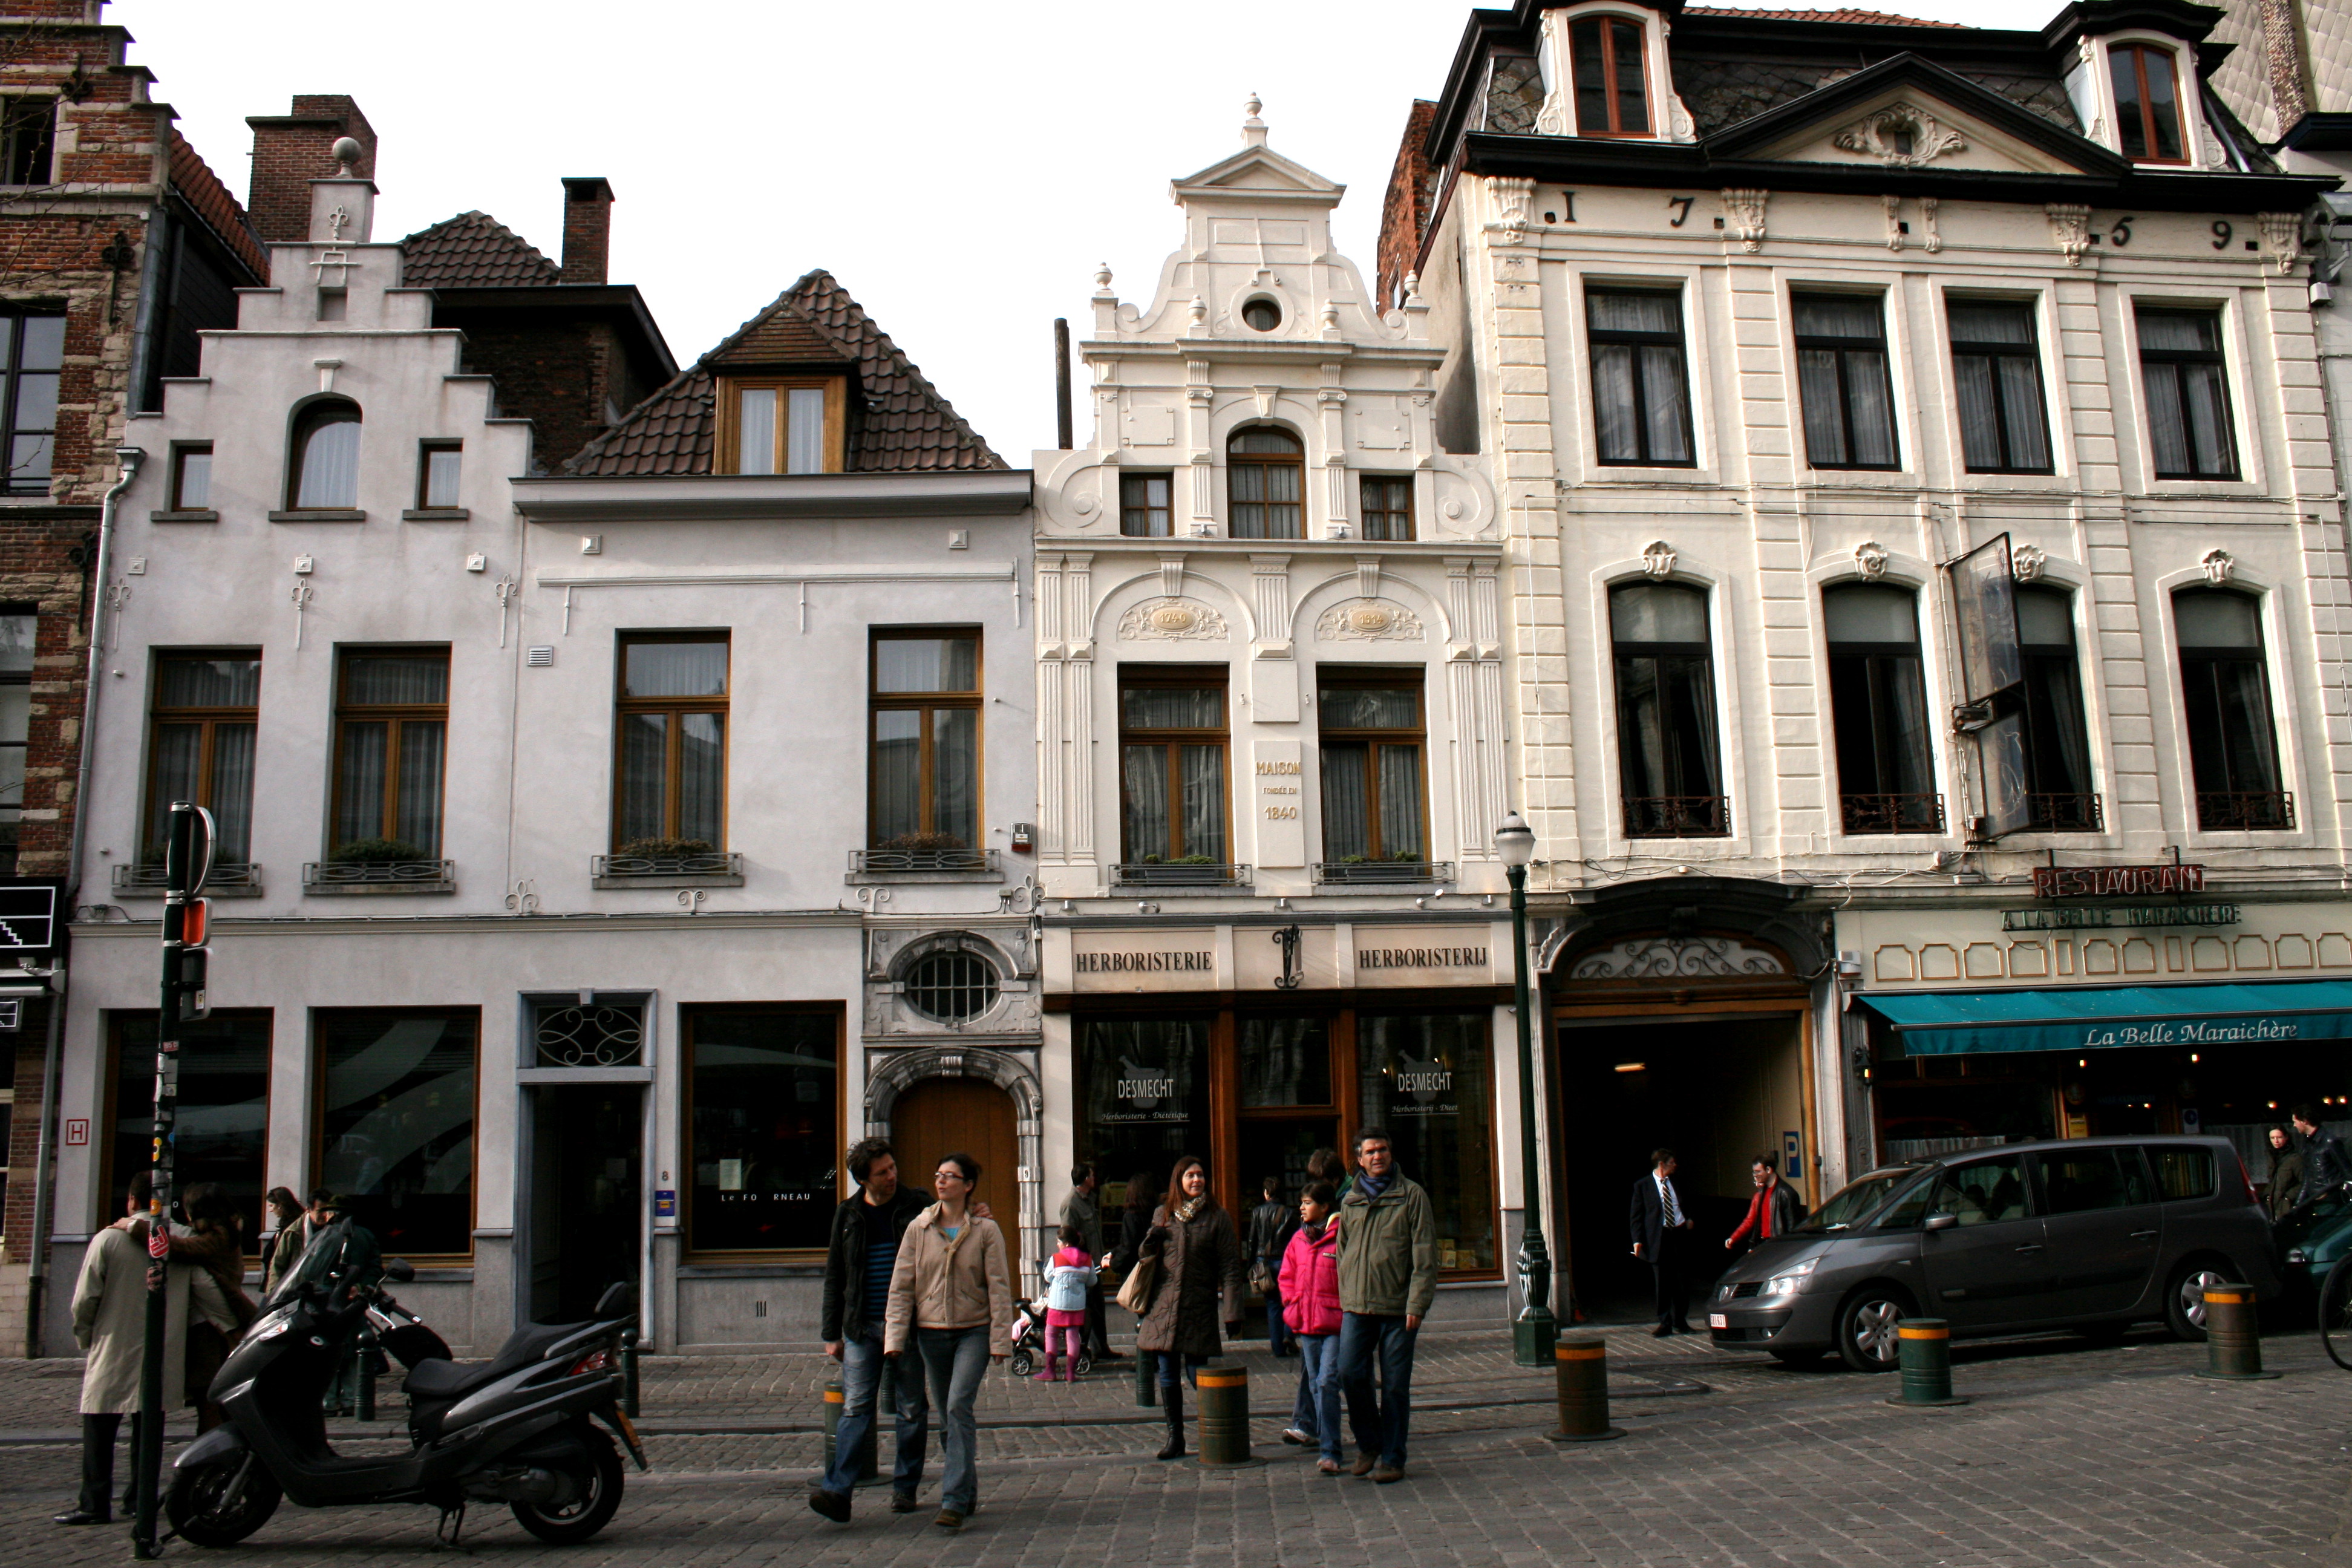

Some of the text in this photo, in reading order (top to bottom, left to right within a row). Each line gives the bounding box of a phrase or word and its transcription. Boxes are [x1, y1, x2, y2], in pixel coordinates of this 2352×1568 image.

[1359, 614, 1383, 624] 1914
[1255, 761, 1301, 775] MAISON
[1264, 806, 1297, 820] 1840
[2036, 867, 2205, 898] RESTAURANT
[1076, 952, 1212, 972] HERBORISTERIE
[1359, 947, 1487, 969] HERBORISTERIJ
[2084, 1019, 2298, 1046] La Belle Maraichère
[1118, 1079, 1174, 1099] DESMECHT
[1397, 1072, 1452, 1091] DESMECHT
[71, 1124, 83, 1140] H
[1785, 1135, 1798, 1173] P
[662, 1171, 668, 1181] 8
